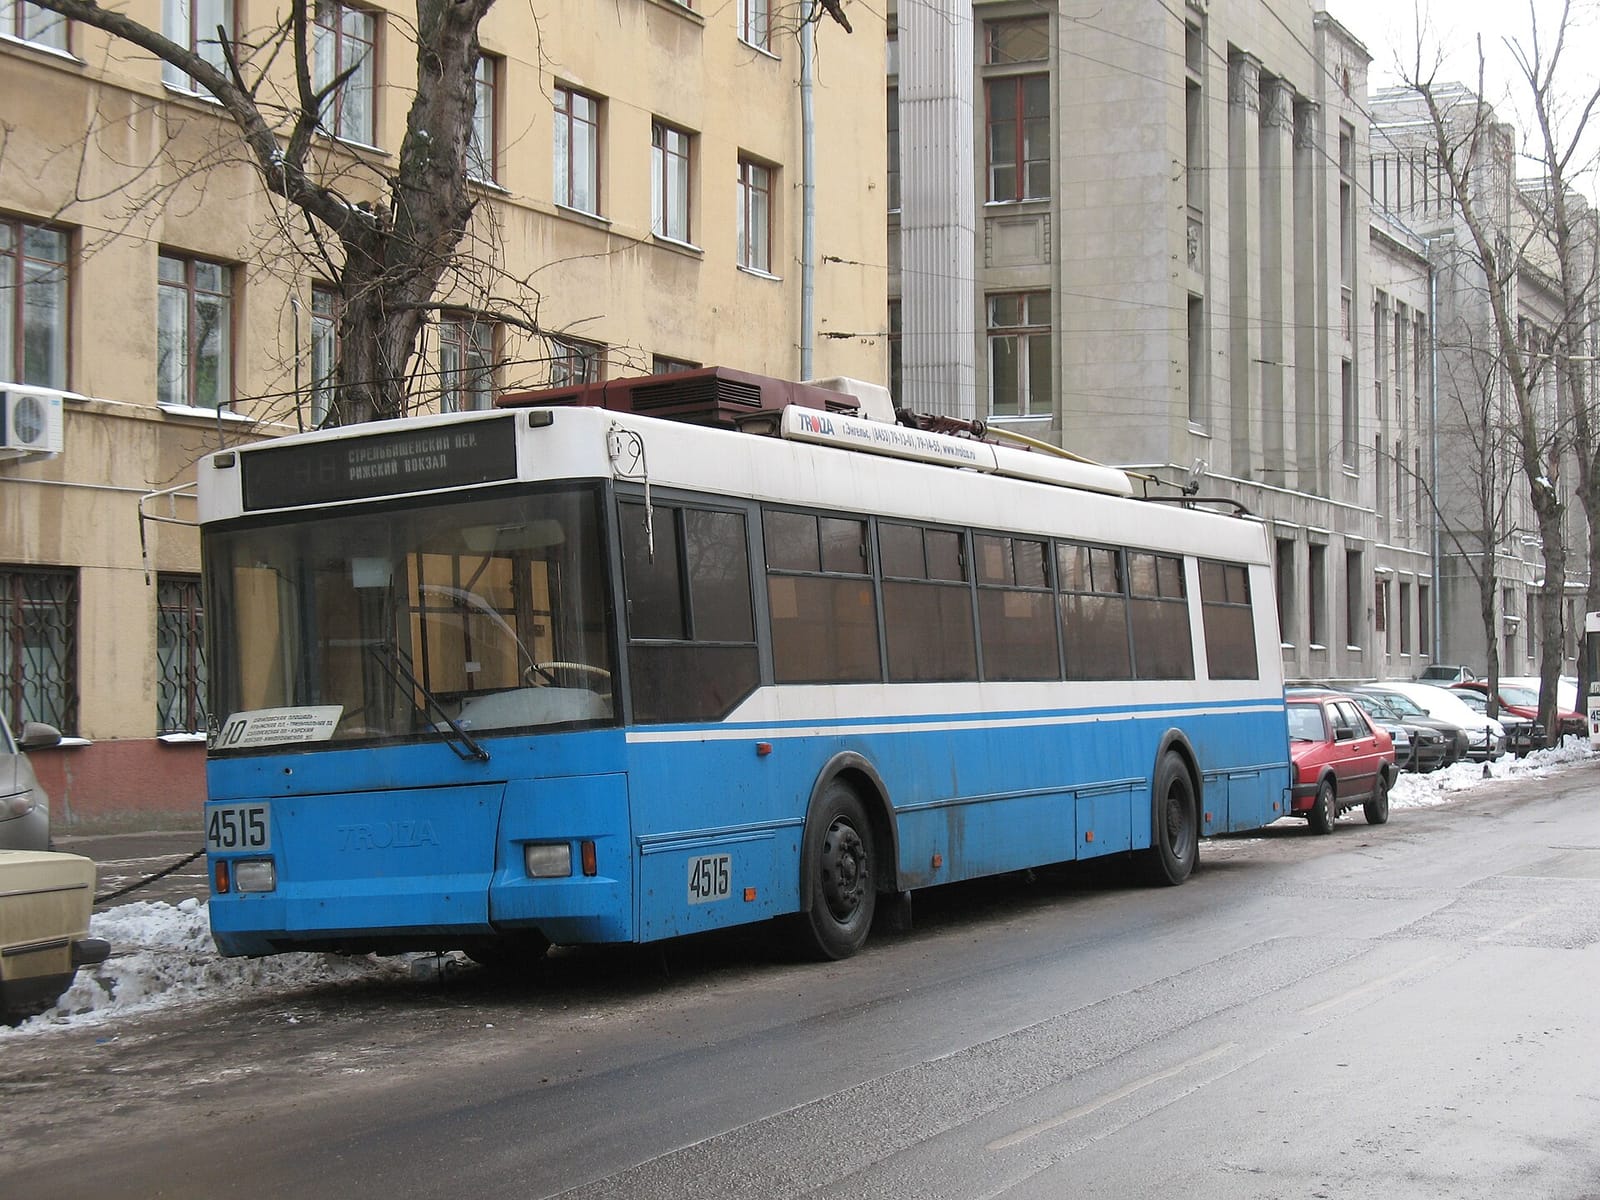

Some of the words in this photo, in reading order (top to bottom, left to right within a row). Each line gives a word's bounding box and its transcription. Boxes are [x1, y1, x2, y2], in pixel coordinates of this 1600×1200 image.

[798, 413, 835, 436] TROLZA
[349, 459, 398, 480] РИЖСКИЙ
[404, 454, 447, 473] ВОКЗАЛ
[222, 719, 248, 747] 10
[208, 808, 266, 848] 4515
[690, 857, 729, 898] 4515
